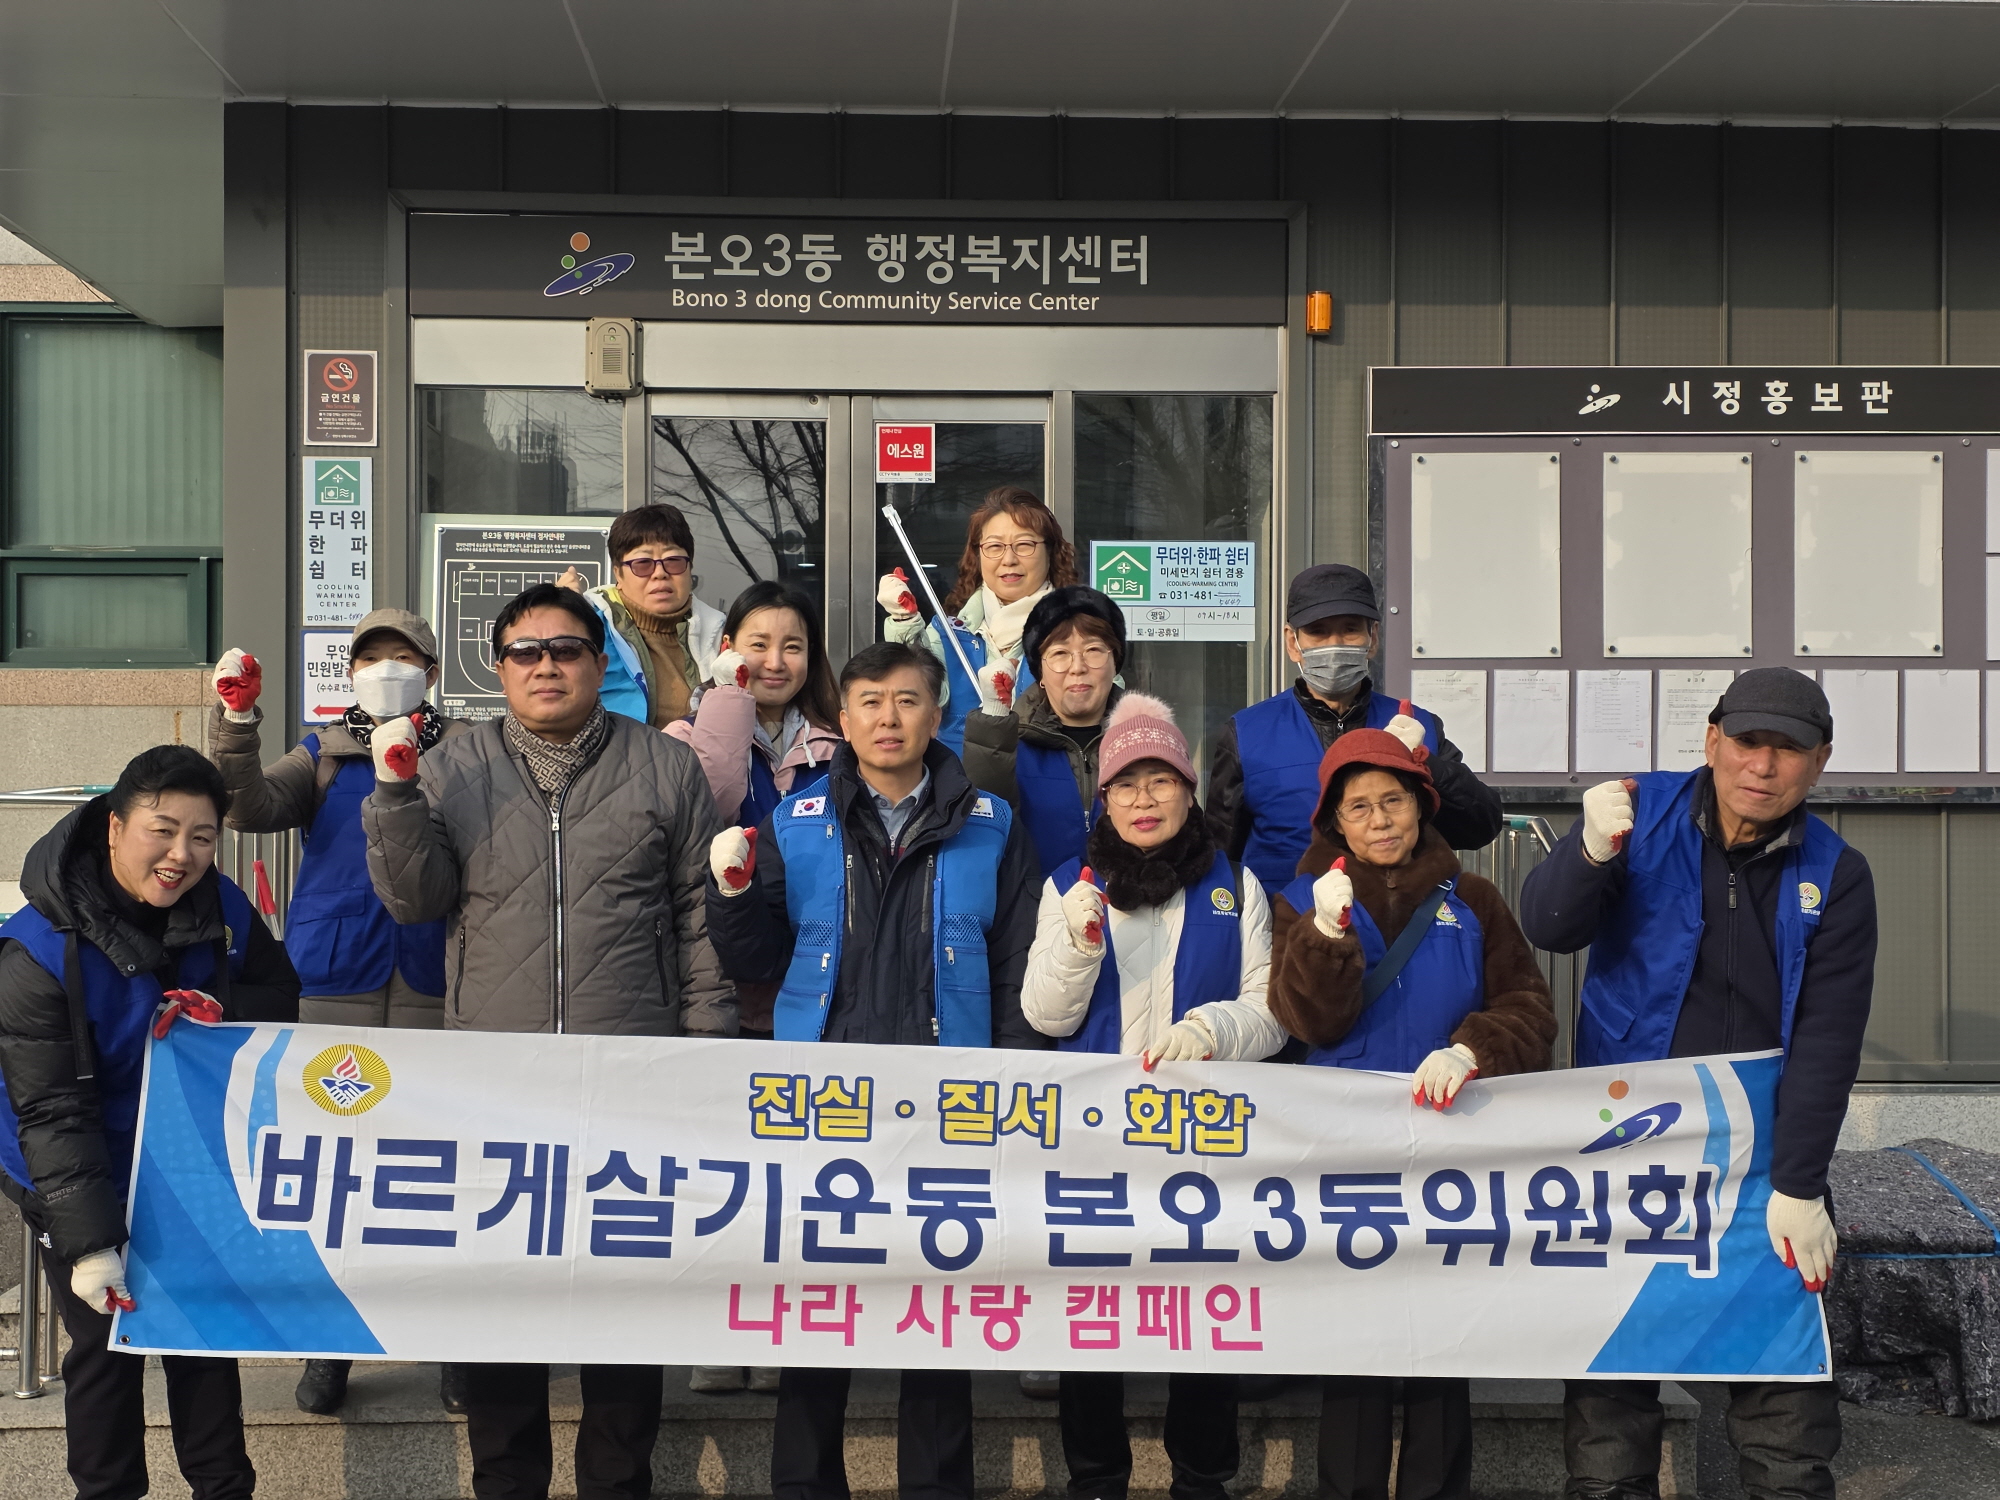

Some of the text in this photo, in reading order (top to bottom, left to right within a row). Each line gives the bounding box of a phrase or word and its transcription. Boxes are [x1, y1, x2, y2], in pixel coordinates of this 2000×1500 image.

[664, 231, 1148, 285] 본오3동 행정복지센터
[672, 289, 1099, 314] Bono 3 dong Community Service Center
[321, 393, 360, 403] 금연건물
[886, 443, 925, 459] 에스원
[308, 510, 366, 530] 무더위
[1156, 546, 1249, 566] 무더위·한파 쉼터
[1160, 567, 1245, 579] 미세먼지 쉼터 겸용
[1150, 610, 1166, 620] 평일
[316, 683, 340, 693] (수수료
[749, 1072, 1256, 1158] 진실 질서 화합
[256, 1132, 1713, 1272] 바르게살기운동 본오3동위원회
[728, 1284, 1264, 1353] 나라 사랑 캠페인
